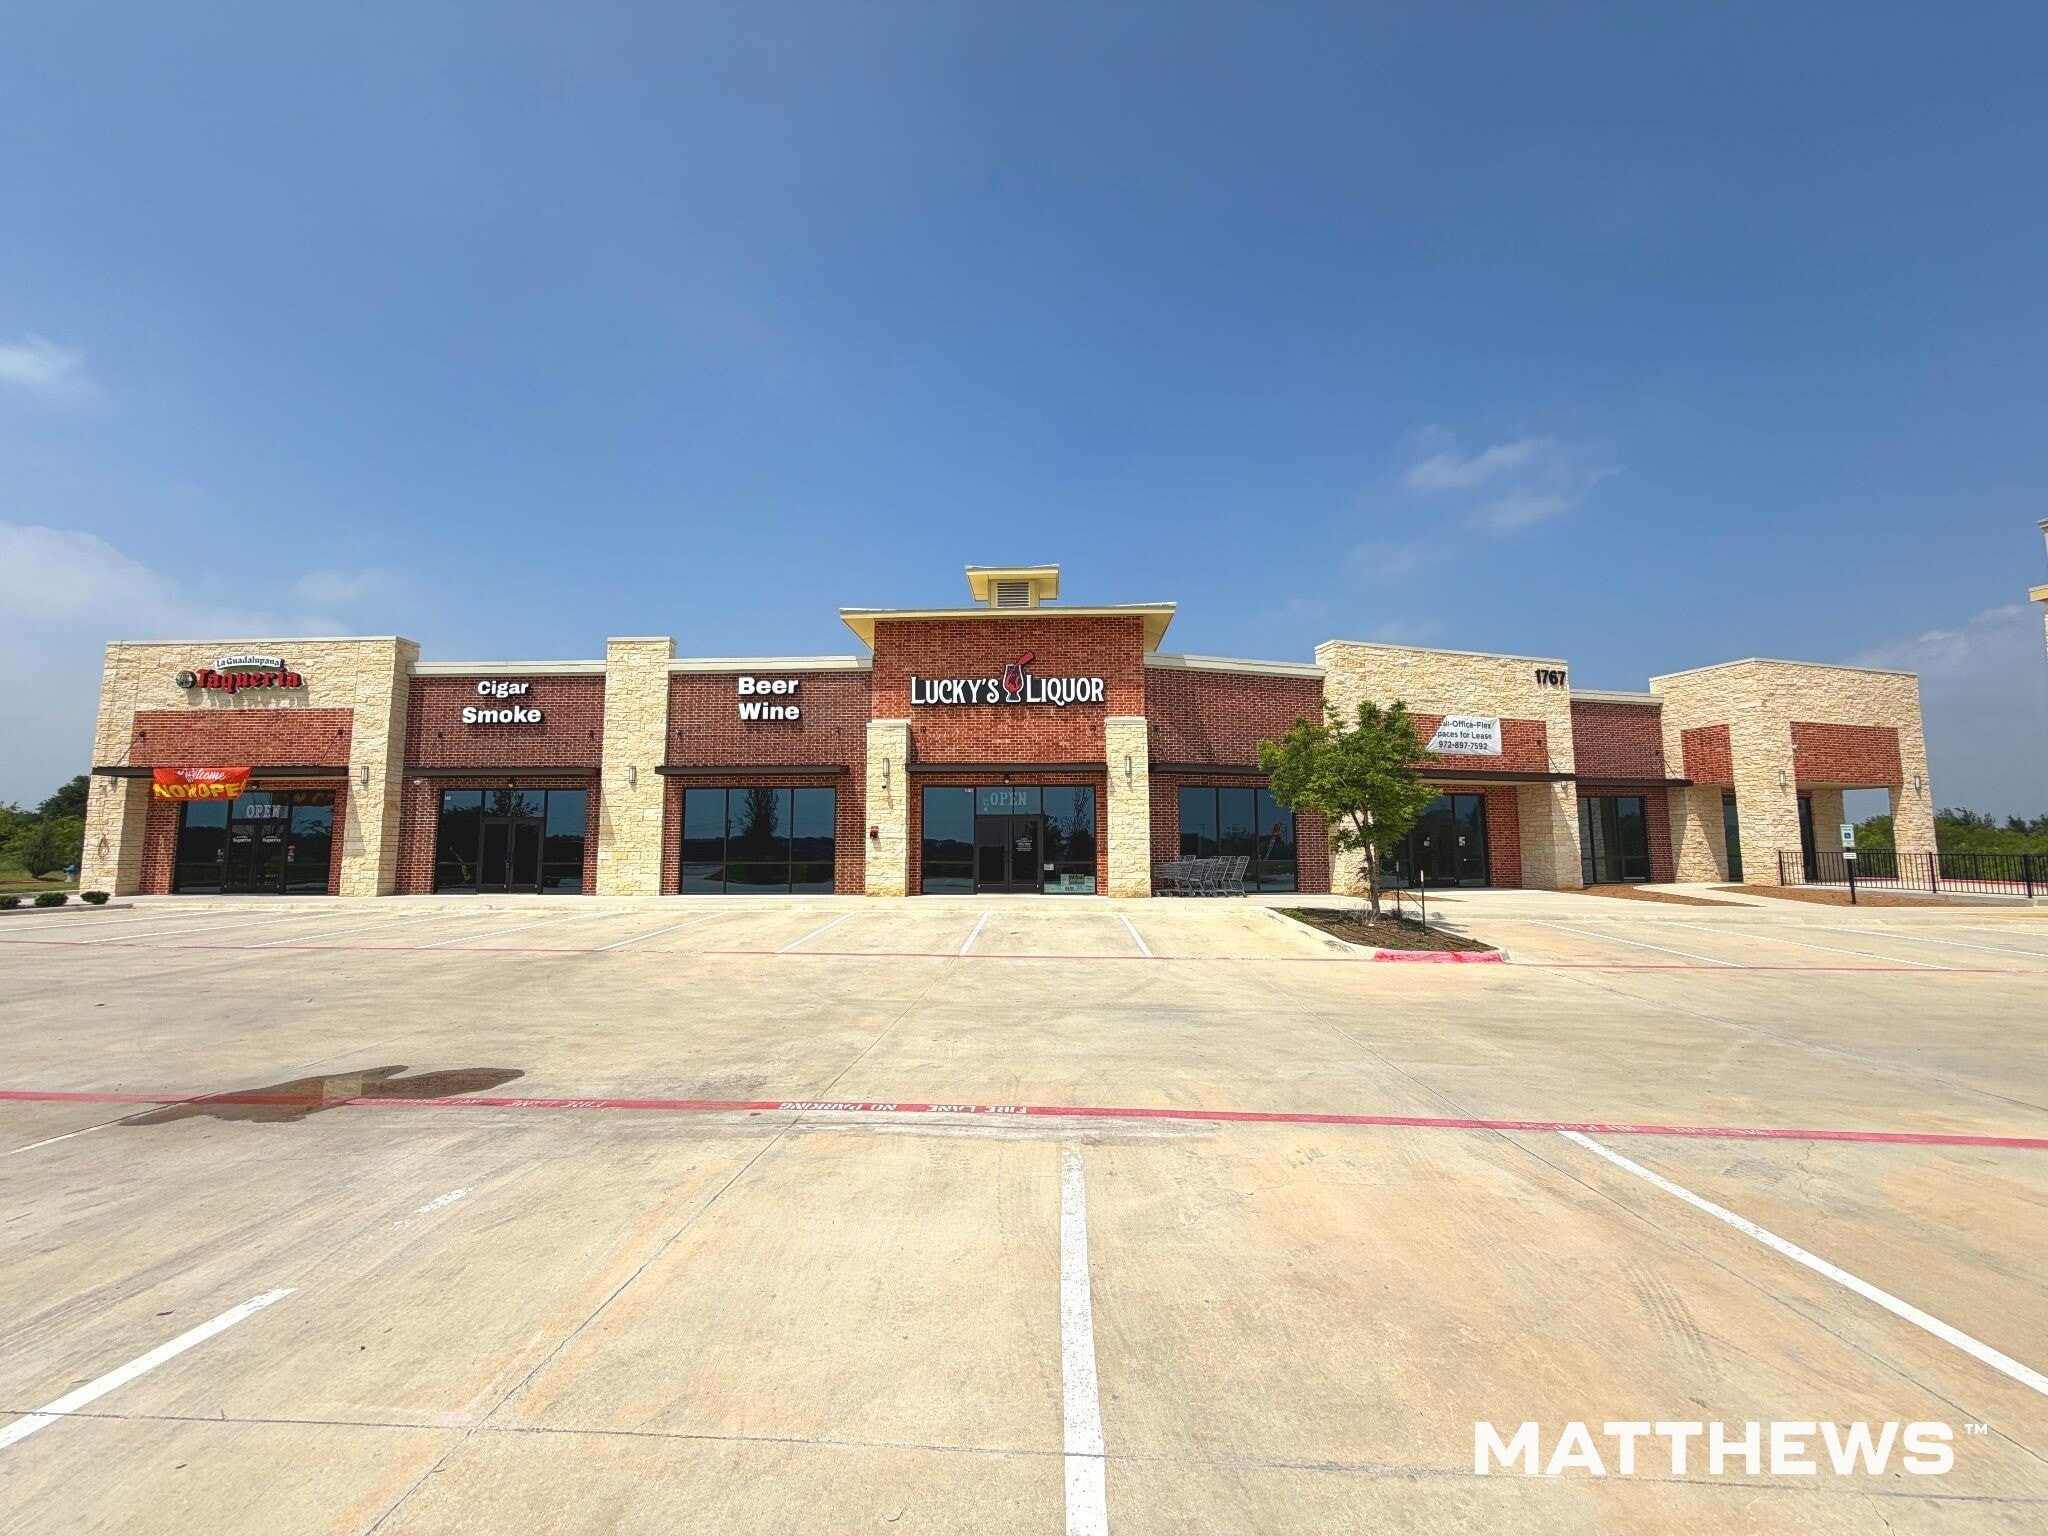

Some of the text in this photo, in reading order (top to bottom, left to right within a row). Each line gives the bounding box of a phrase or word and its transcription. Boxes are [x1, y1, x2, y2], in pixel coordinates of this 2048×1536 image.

[226, 656, 280, 666] Guadalupana
[1535, 669, 1566, 686] 1767
[477, 680, 529, 698] Cigar
[738, 677, 799, 695] Beer
[1025, 674, 1105, 706] LIQUOR
[462, 705, 542, 724] Smoke
[738, 701, 800, 720] Wine
[1460, 731, 1470, 739] for
[1471, 732, 1492, 740] Lease
[1438, 740, 1488, 750] 972-897-7592
[177, 767, 228, 783] Welcome
[990, 791, 1027, 806] OPEN
[246, 804, 281, 818] OPEN
[869, 1103, 898, 1112] NO
[927, 1104, 977, 1113] LANE
[984, 1105, 1028, 1114] FIRE
